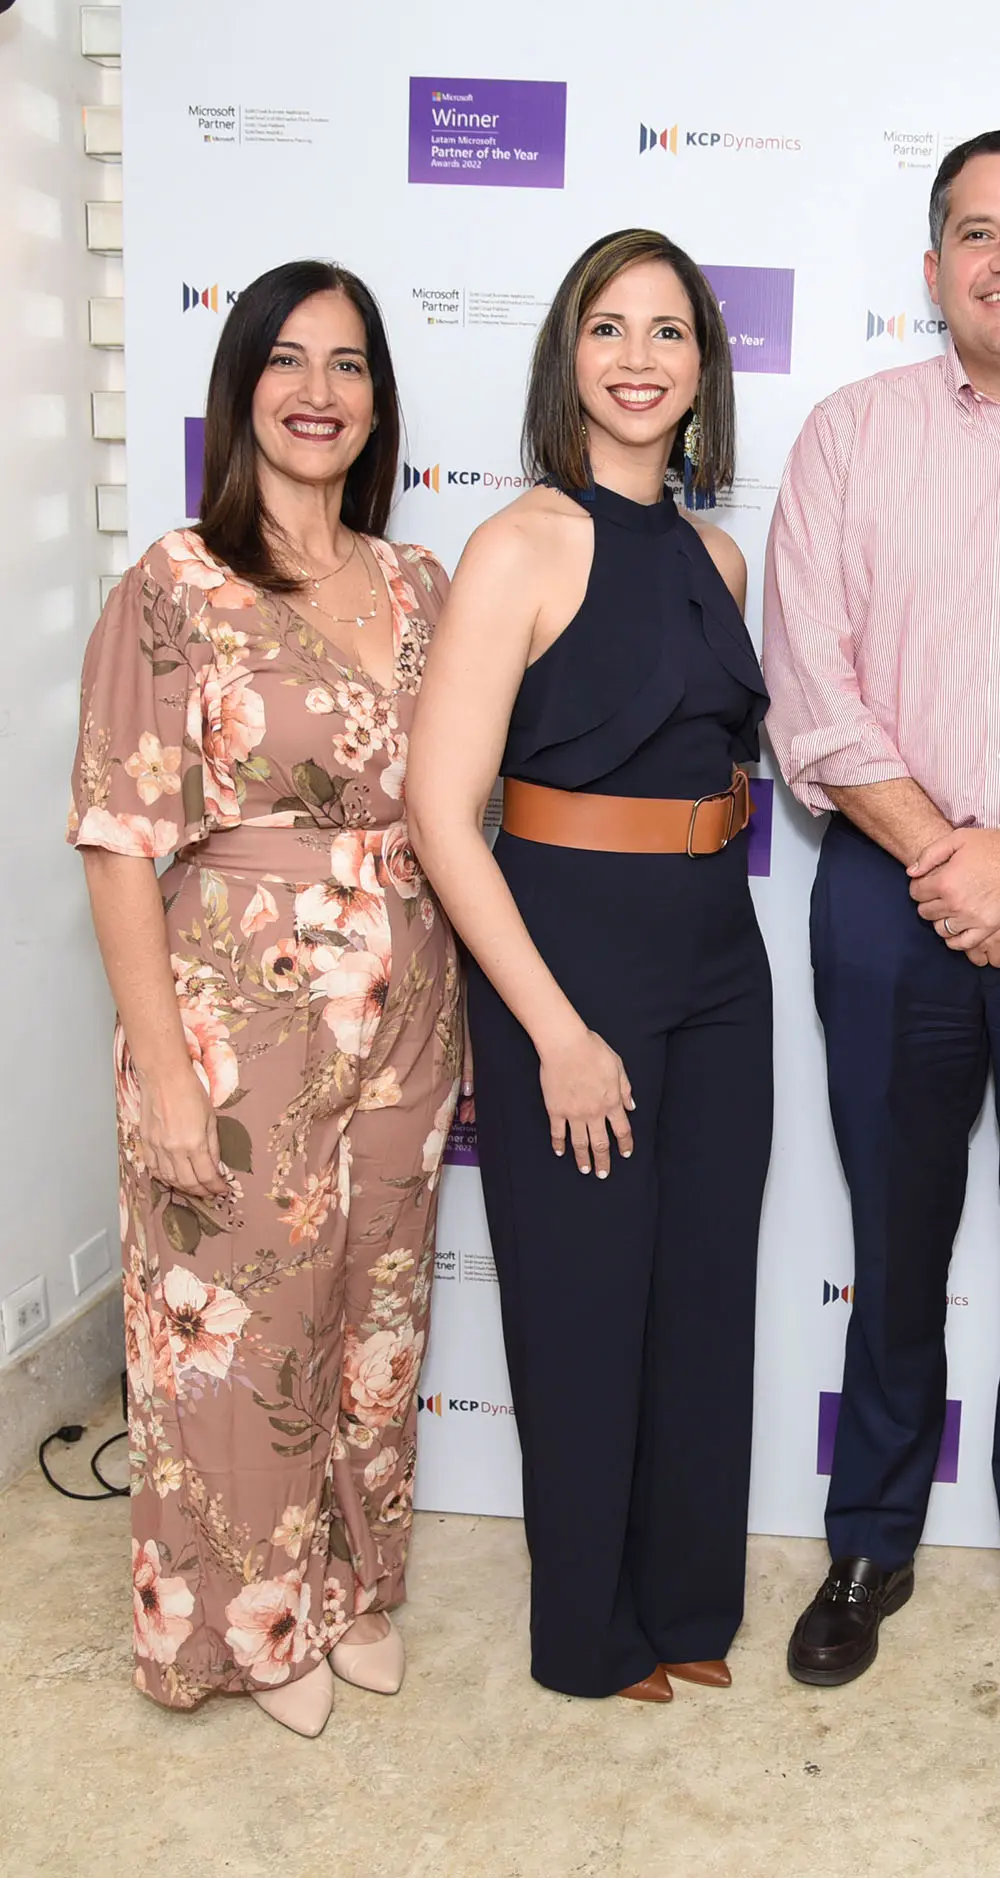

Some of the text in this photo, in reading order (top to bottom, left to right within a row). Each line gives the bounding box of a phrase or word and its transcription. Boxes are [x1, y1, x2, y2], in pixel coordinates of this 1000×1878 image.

[442, 93, 473, 102] Microsoft
[188, 105, 235, 117] Microsoft
[198, 118, 235, 129] Partner
[432, 108, 499, 128] Winner
[431, 136, 496, 145] Latam Microsoft
[686, 132, 801, 151] KCP Dynamics
[884, 131, 932, 143] Microsoft
[431, 146, 539, 161] Partner of the Year
[894, 144, 932, 156] Partner
[431, 160, 482, 169] Awards 2022
[412, 288, 459, 300] Microsoft
[422, 300, 459, 312] Partner
[913, 319, 948, 335] KCP
[740, 334, 765, 346] Year
[448, 470, 535, 490] KCP Dynam
[436, 1262, 456, 1271] tner
[449, 1399, 516, 1417] KCP Dyna
